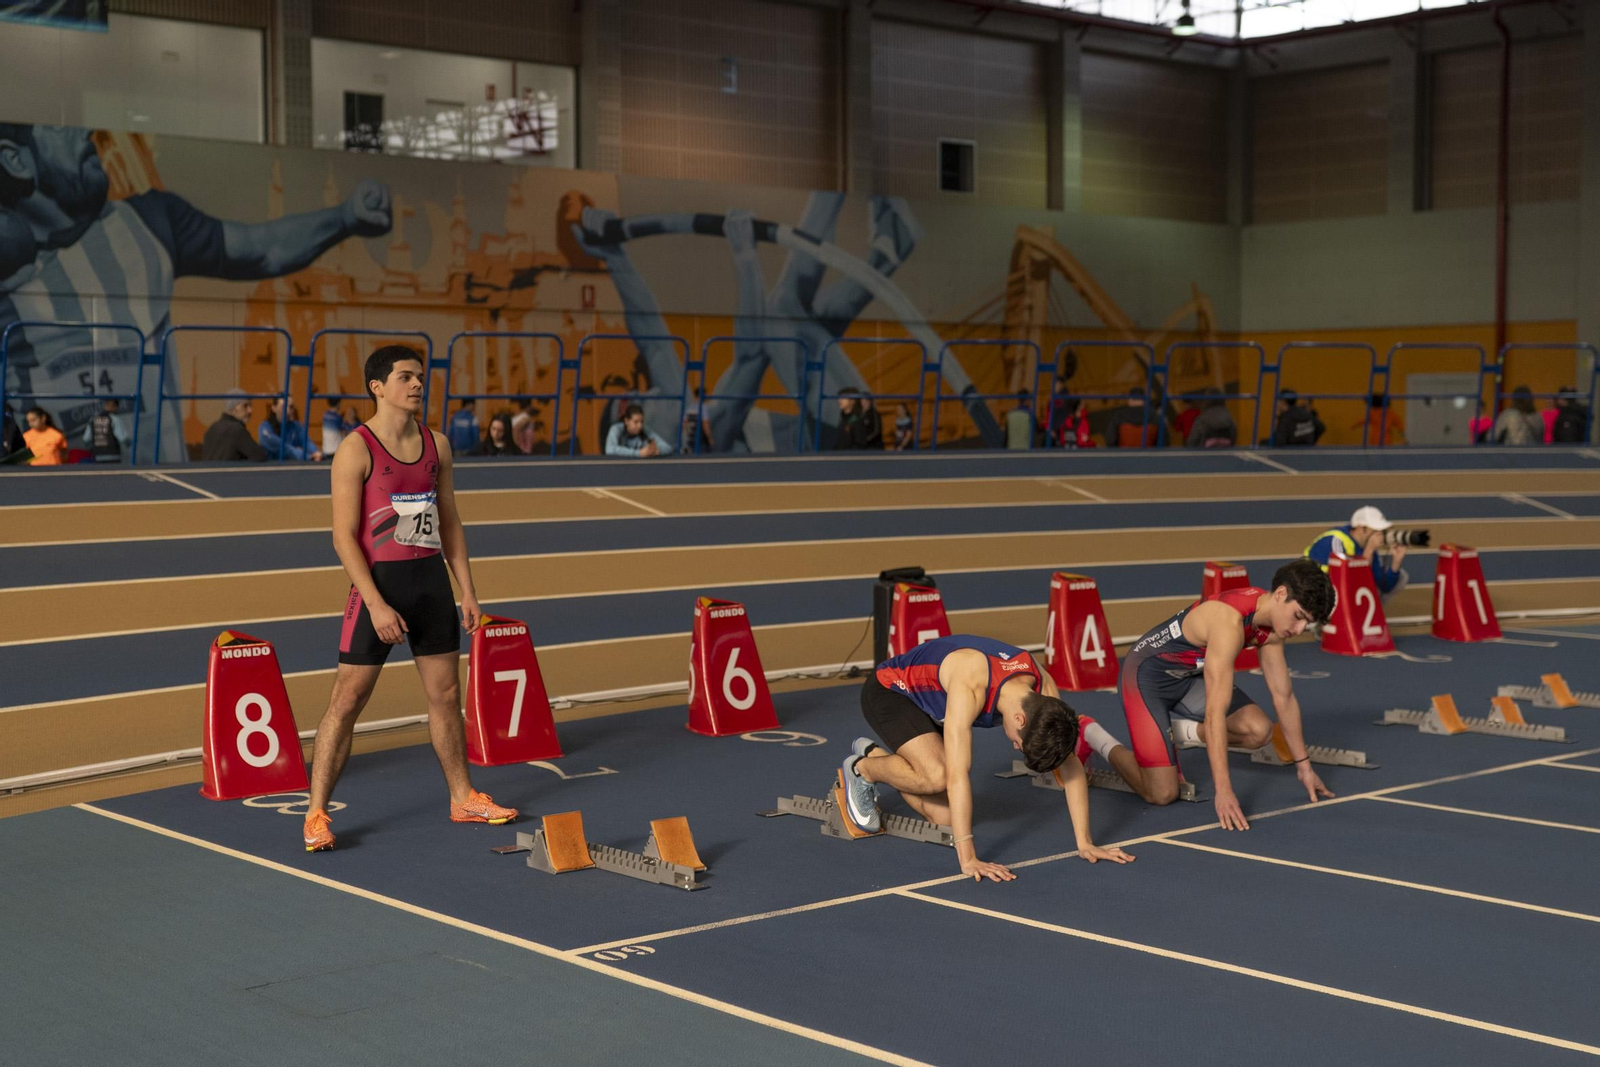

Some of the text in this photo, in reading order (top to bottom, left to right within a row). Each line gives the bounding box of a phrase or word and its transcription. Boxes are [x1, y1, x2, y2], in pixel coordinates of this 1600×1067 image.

[78, 369, 113, 396] 54
[413, 513, 433, 535] 15
[1069, 582, 1096, 590] MONDO
[909, 593, 940, 603] MONDO
[1467, 579, 1488, 625] 1
[711, 608, 745, 619] MONDO
[1355, 587, 1382, 635] 2
[485, 626, 526, 638] MONDO
[1080, 614, 1106, 668] 4
[1133, 628, 1169, 652] DE GALICIA
[1150, 634, 1171, 648] XUNTA
[221, 646, 271, 659] MONDO
[723, 647, 756, 711] 6
[493, 669, 527, 738] 7
[235, 692, 280, 768] 8
[594, 945, 656, 961] 60
